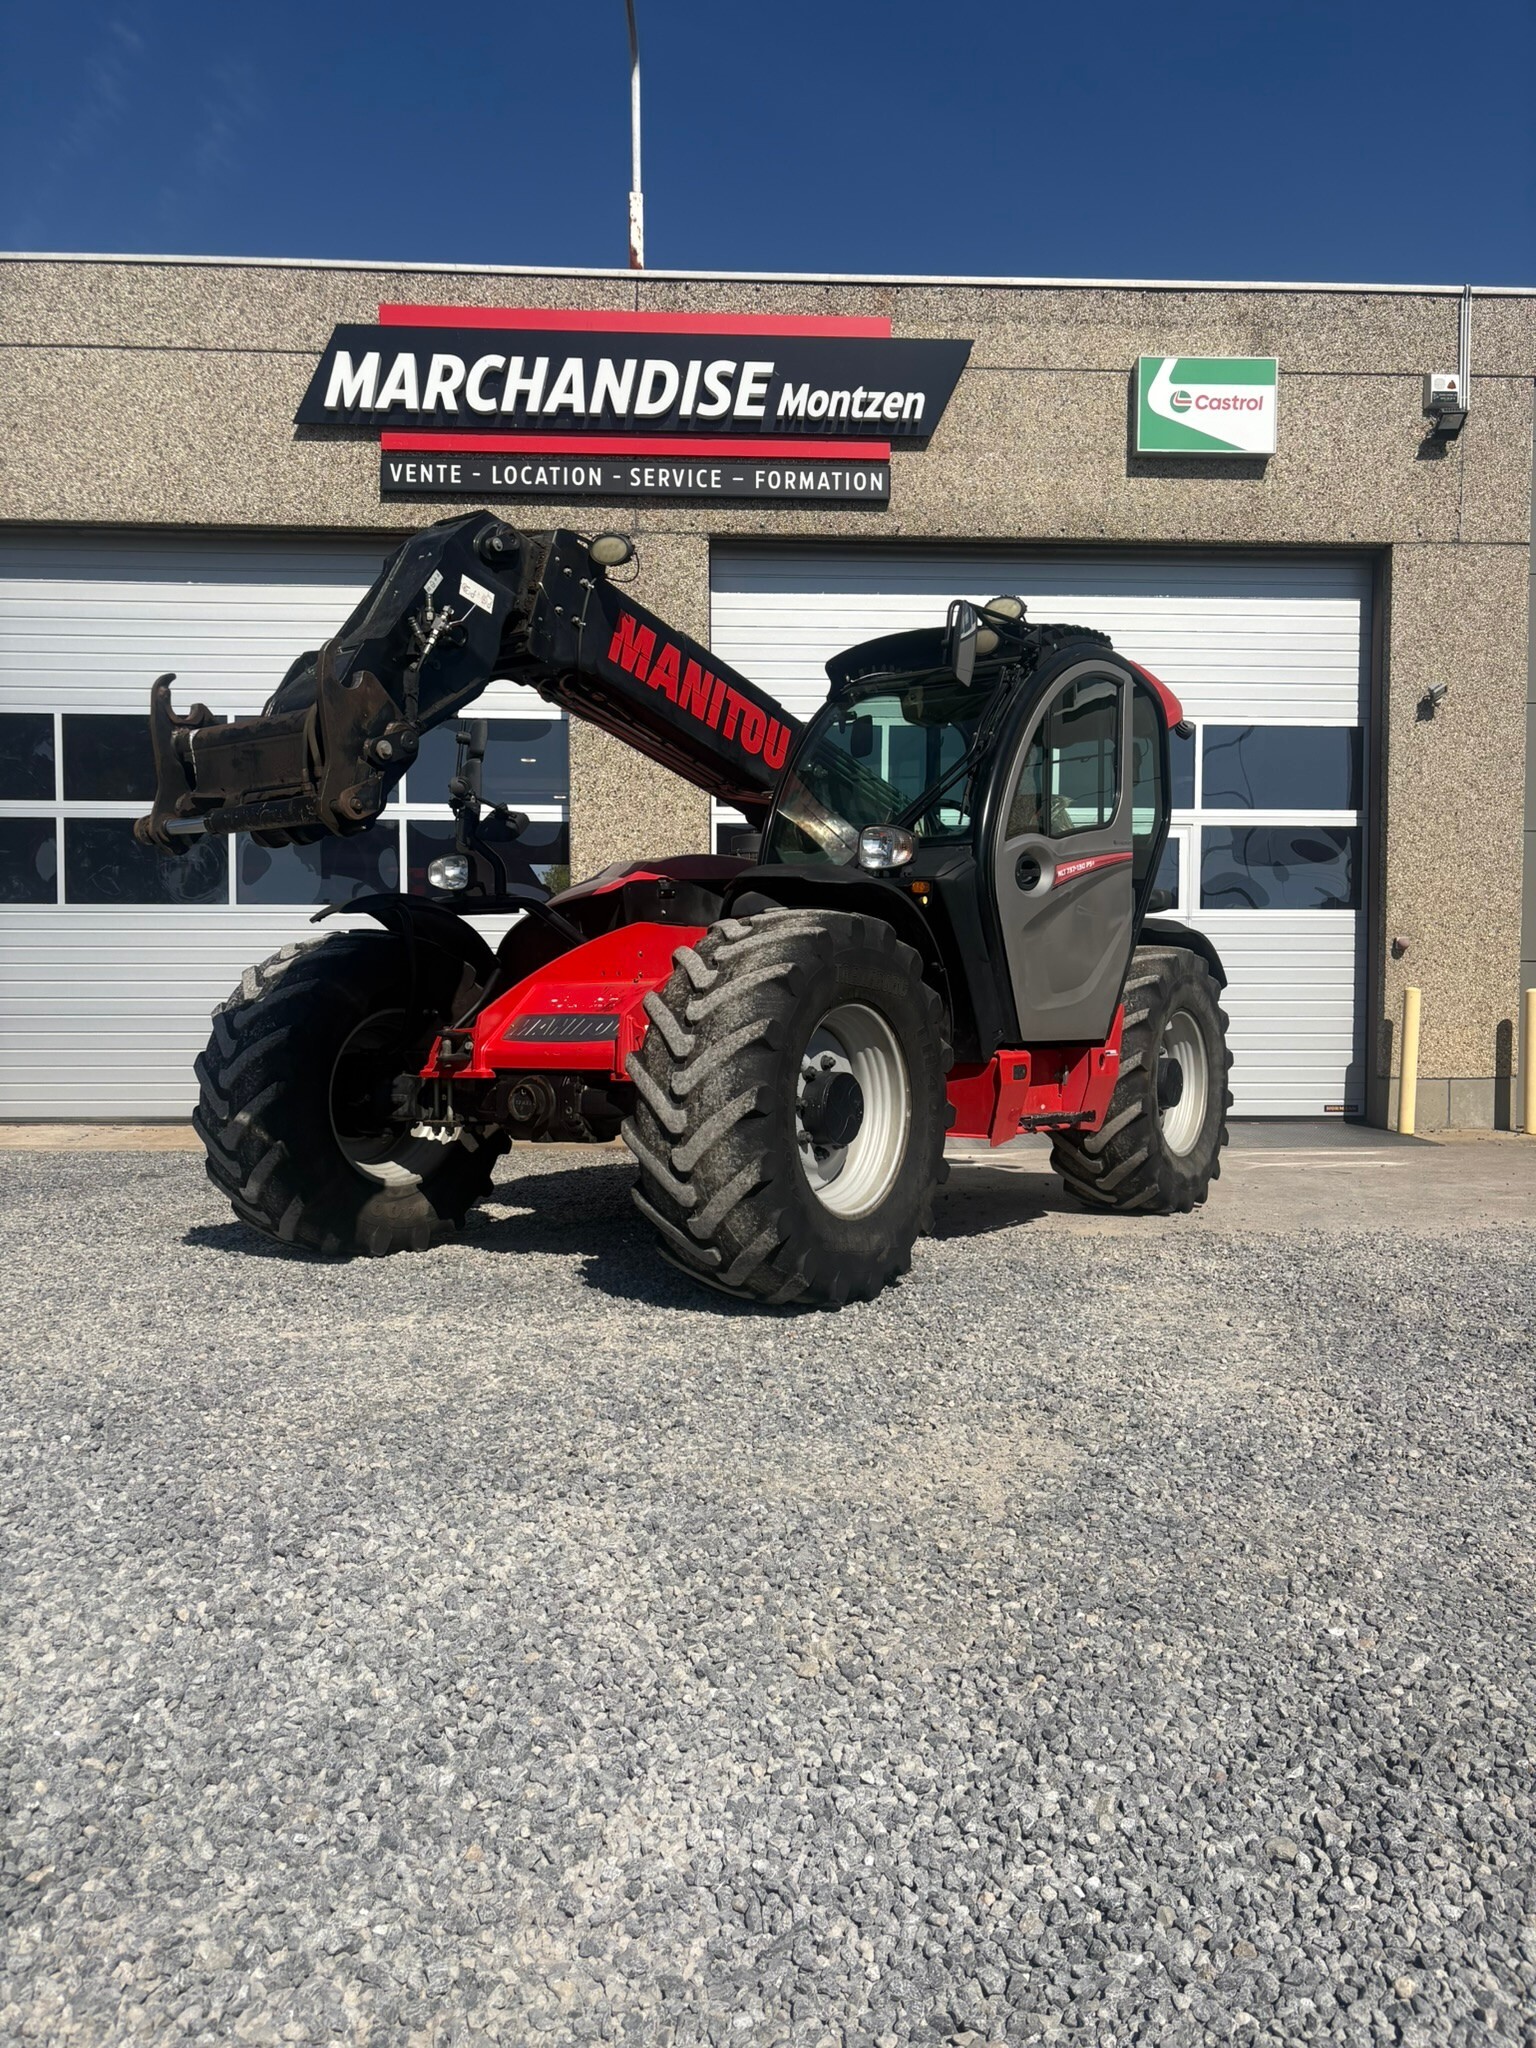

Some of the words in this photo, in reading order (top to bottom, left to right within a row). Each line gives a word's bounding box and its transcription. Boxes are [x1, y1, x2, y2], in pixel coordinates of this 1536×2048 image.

[323, 350, 775, 419] MARCHANDISE
[776, 382, 926, 421] Montzen
[1194, 394, 1264, 411] Castrol
[389, 463, 462, 484] VENTE
[491, 465, 602, 486] LOCATION
[629, 467, 723, 489] SERVICE
[754, 469, 884, 492] FORMATION
[607, 608, 792, 770] MANITOU
